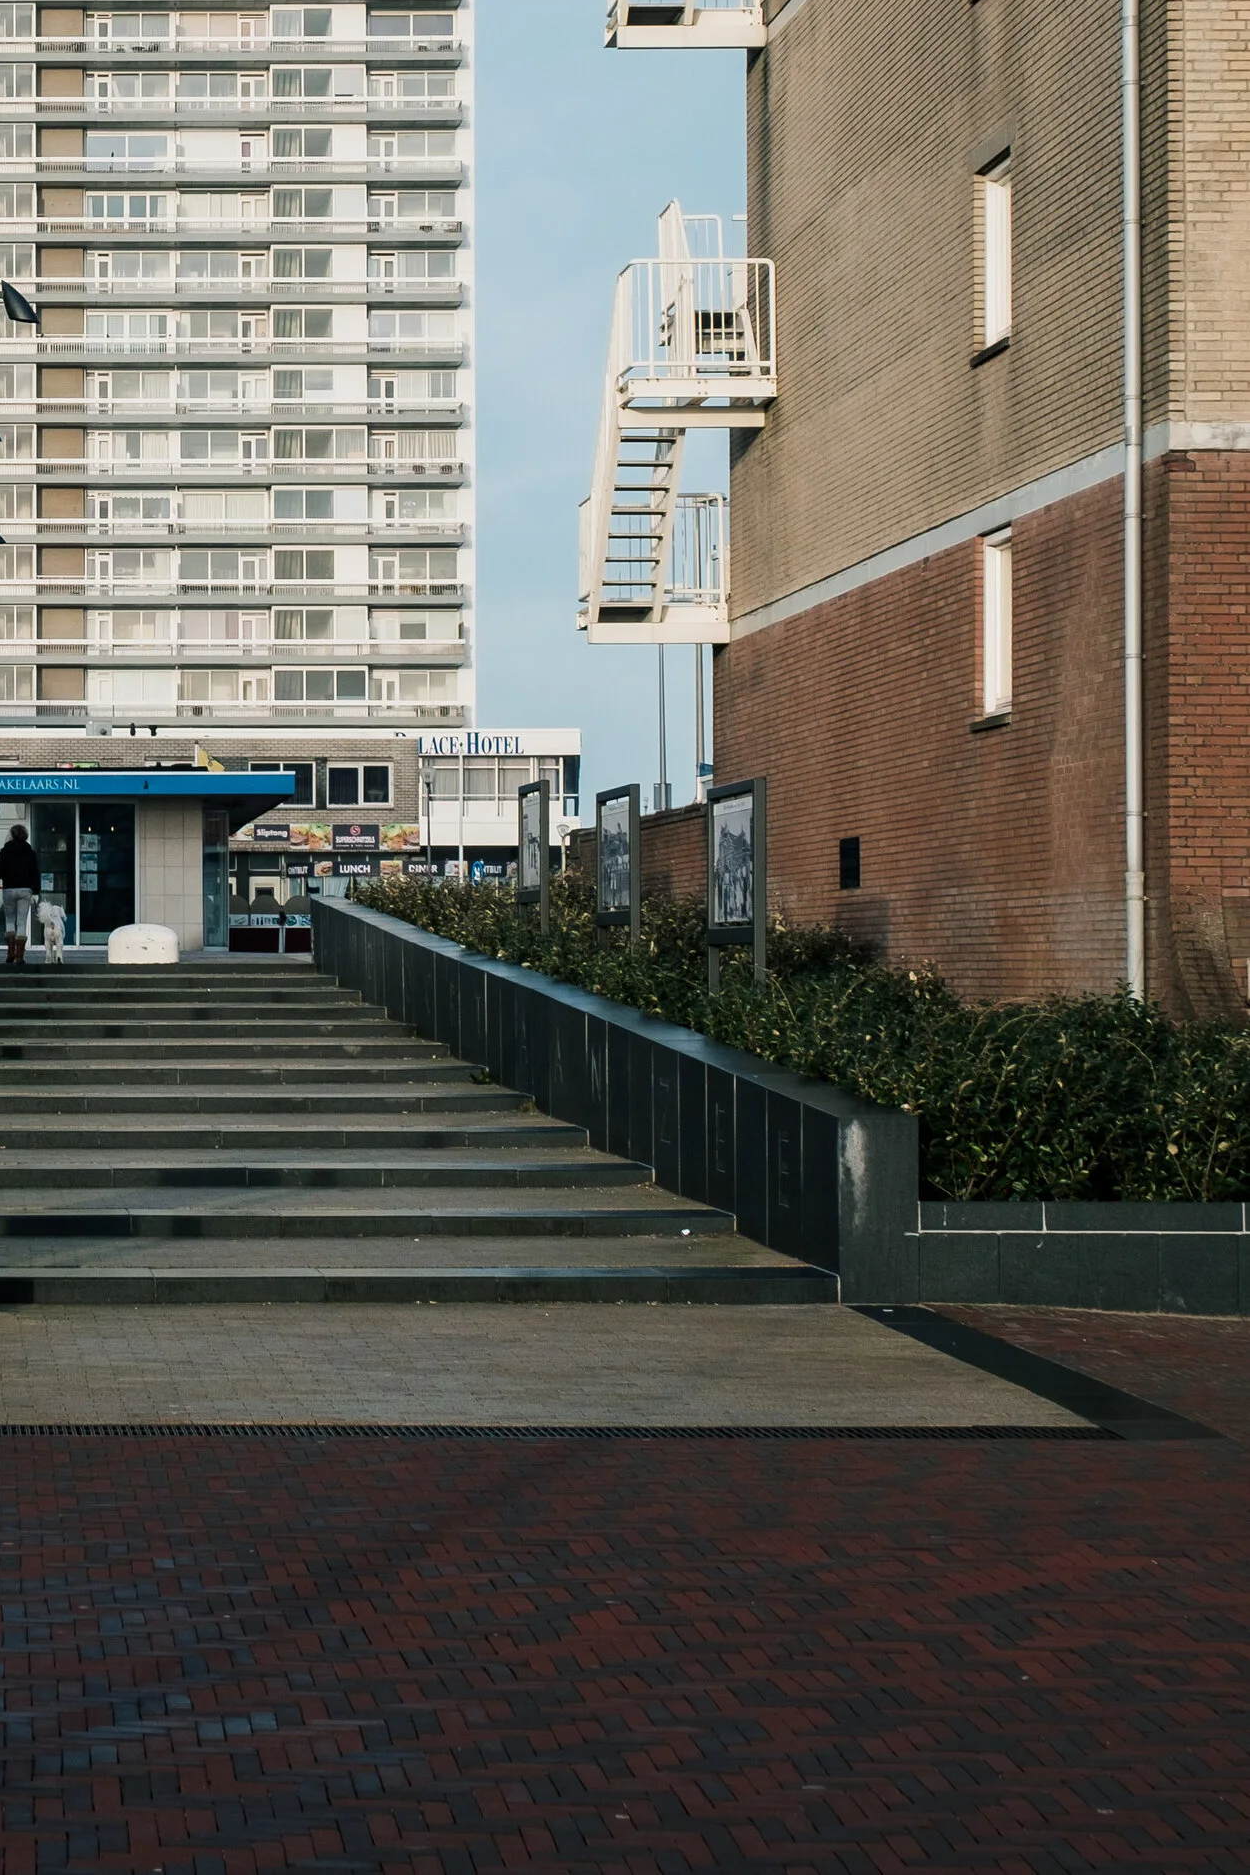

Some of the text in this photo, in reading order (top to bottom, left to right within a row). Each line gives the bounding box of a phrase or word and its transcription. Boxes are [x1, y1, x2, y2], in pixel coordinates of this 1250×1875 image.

[466, 732, 524, 754] HOTEL
[340, 864, 370, 874] LUNCH
[408, 864, 438, 873] DINR
